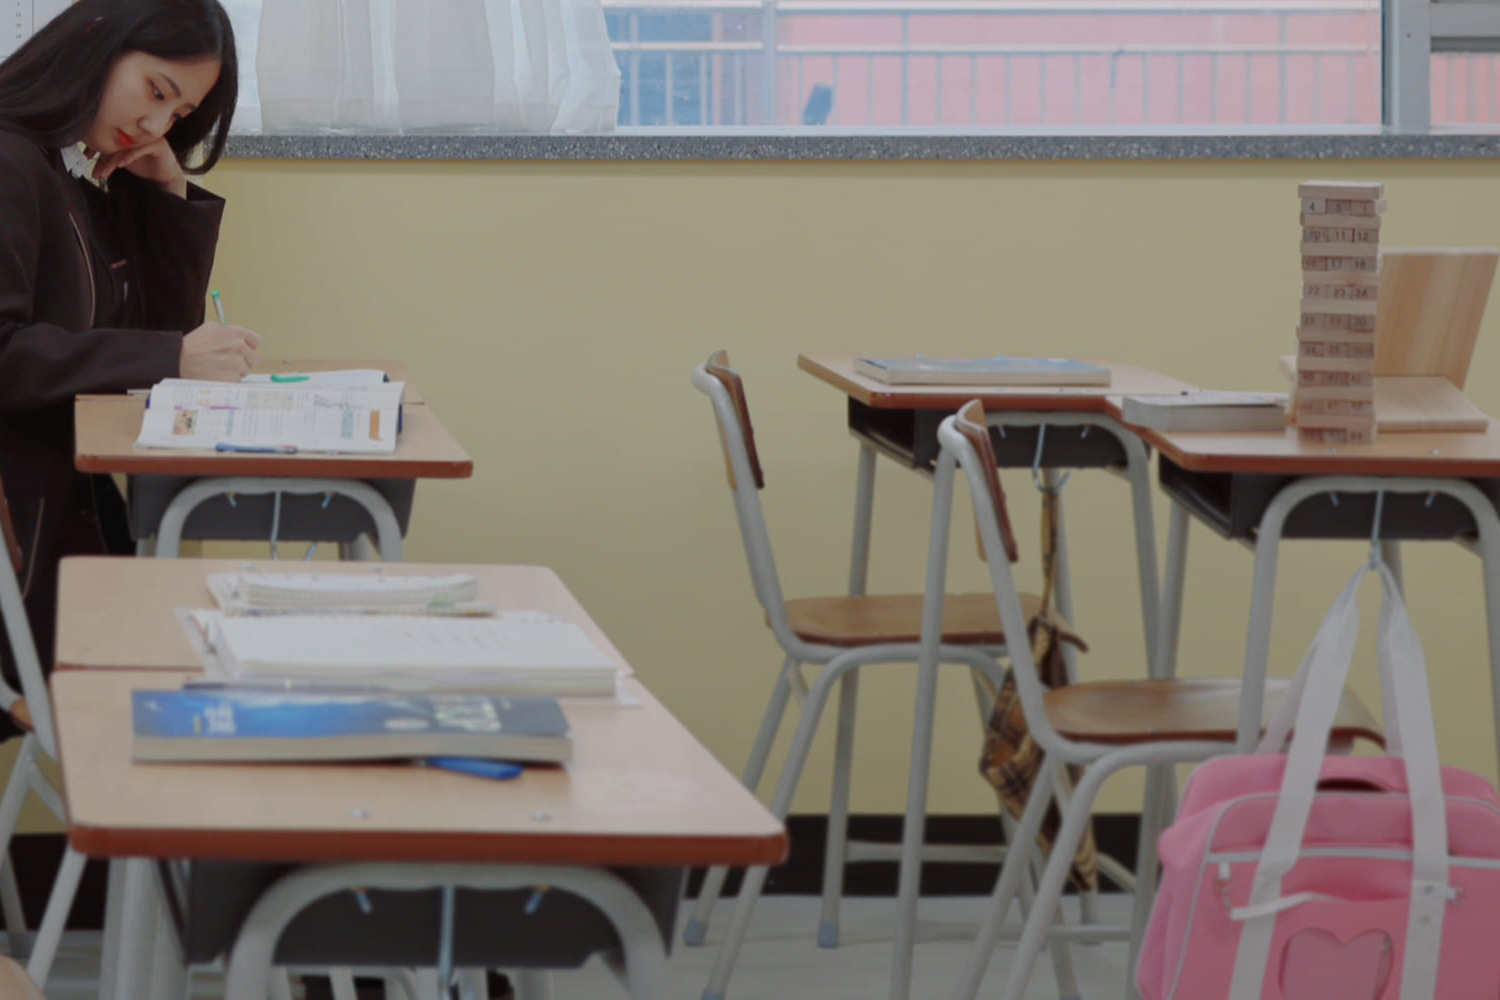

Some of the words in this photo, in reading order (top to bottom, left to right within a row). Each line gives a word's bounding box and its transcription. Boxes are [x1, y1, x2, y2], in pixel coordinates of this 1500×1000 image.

[1308, 201, 1316, 211] 4
[1309, 230, 1322, 241] 10
[1335, 231, 1346, 241] 11
[1357, 231, 1369, 242] 12
